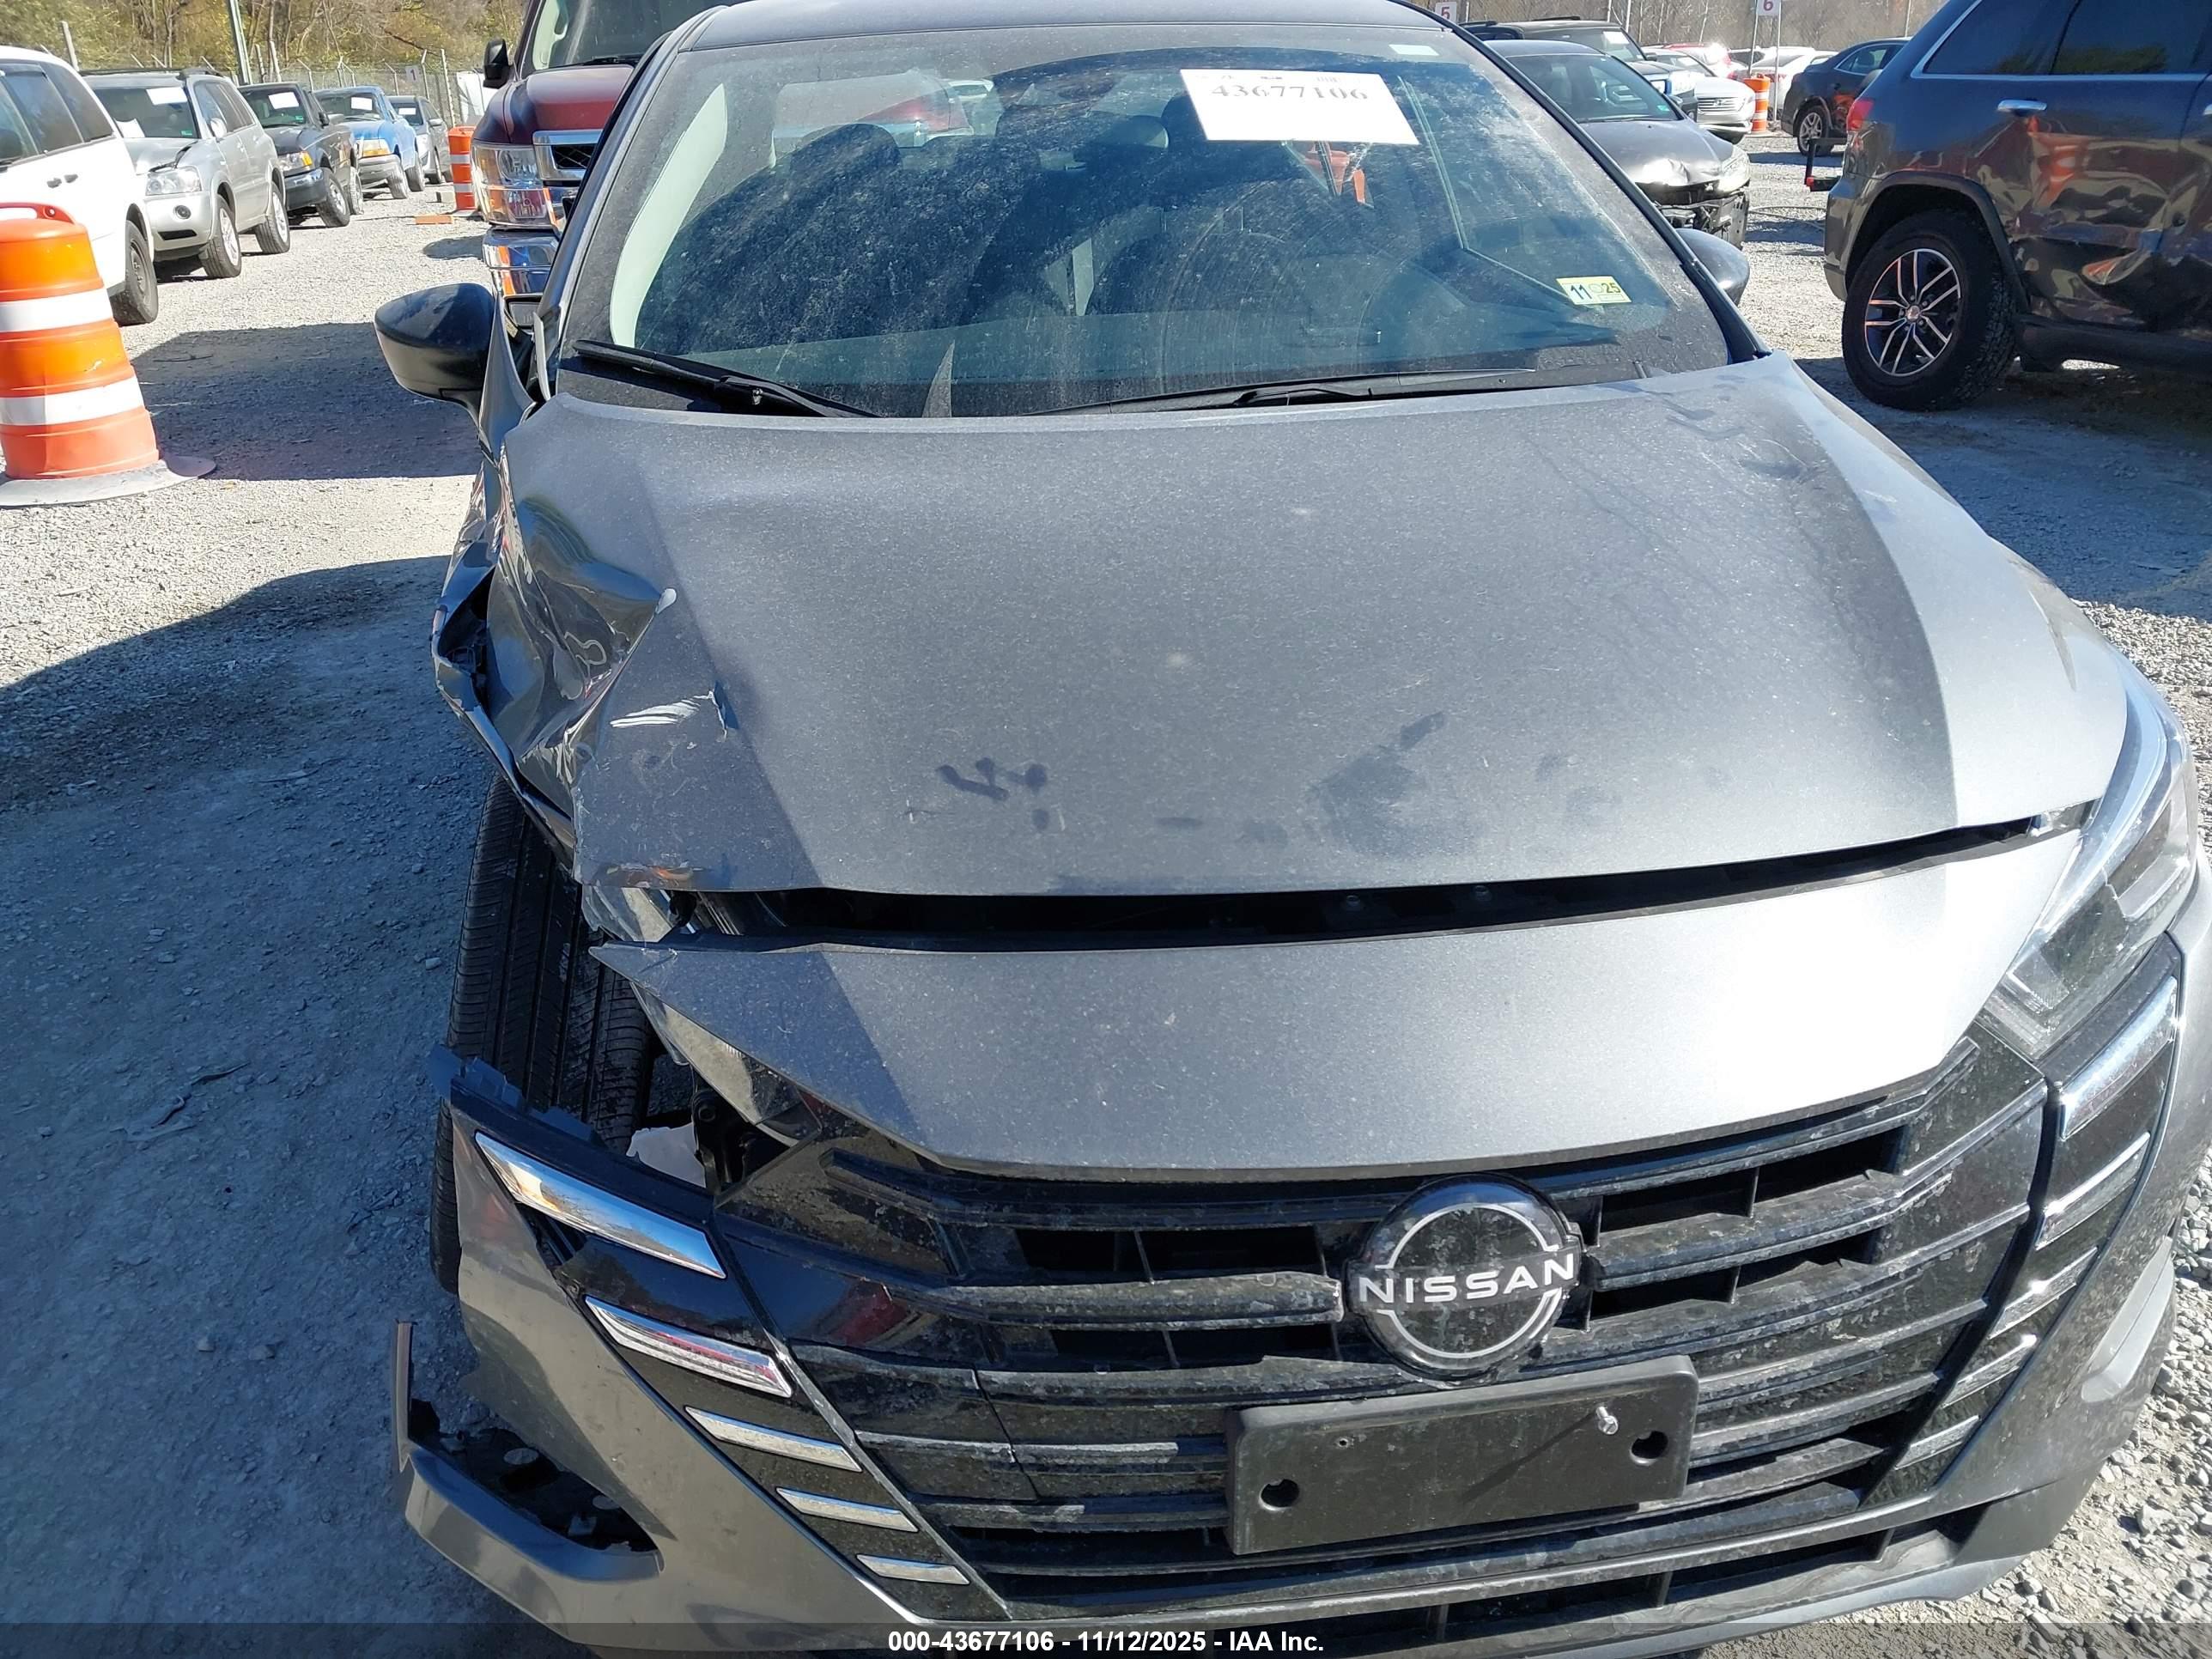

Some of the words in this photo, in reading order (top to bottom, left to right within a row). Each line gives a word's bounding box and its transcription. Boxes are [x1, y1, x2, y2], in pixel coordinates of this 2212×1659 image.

[1441, 6, 1450, 20] 5
[1763, 0, 1774, 11] 6
[410, 68, 416, 82] 1
[1212, 84, 1368, 100] 43677106
[1570, 284, 1593, 300] 11
[1601, 283, 1621, 294] 25
[1358, 1253, 1574, 1304] NISSAN
